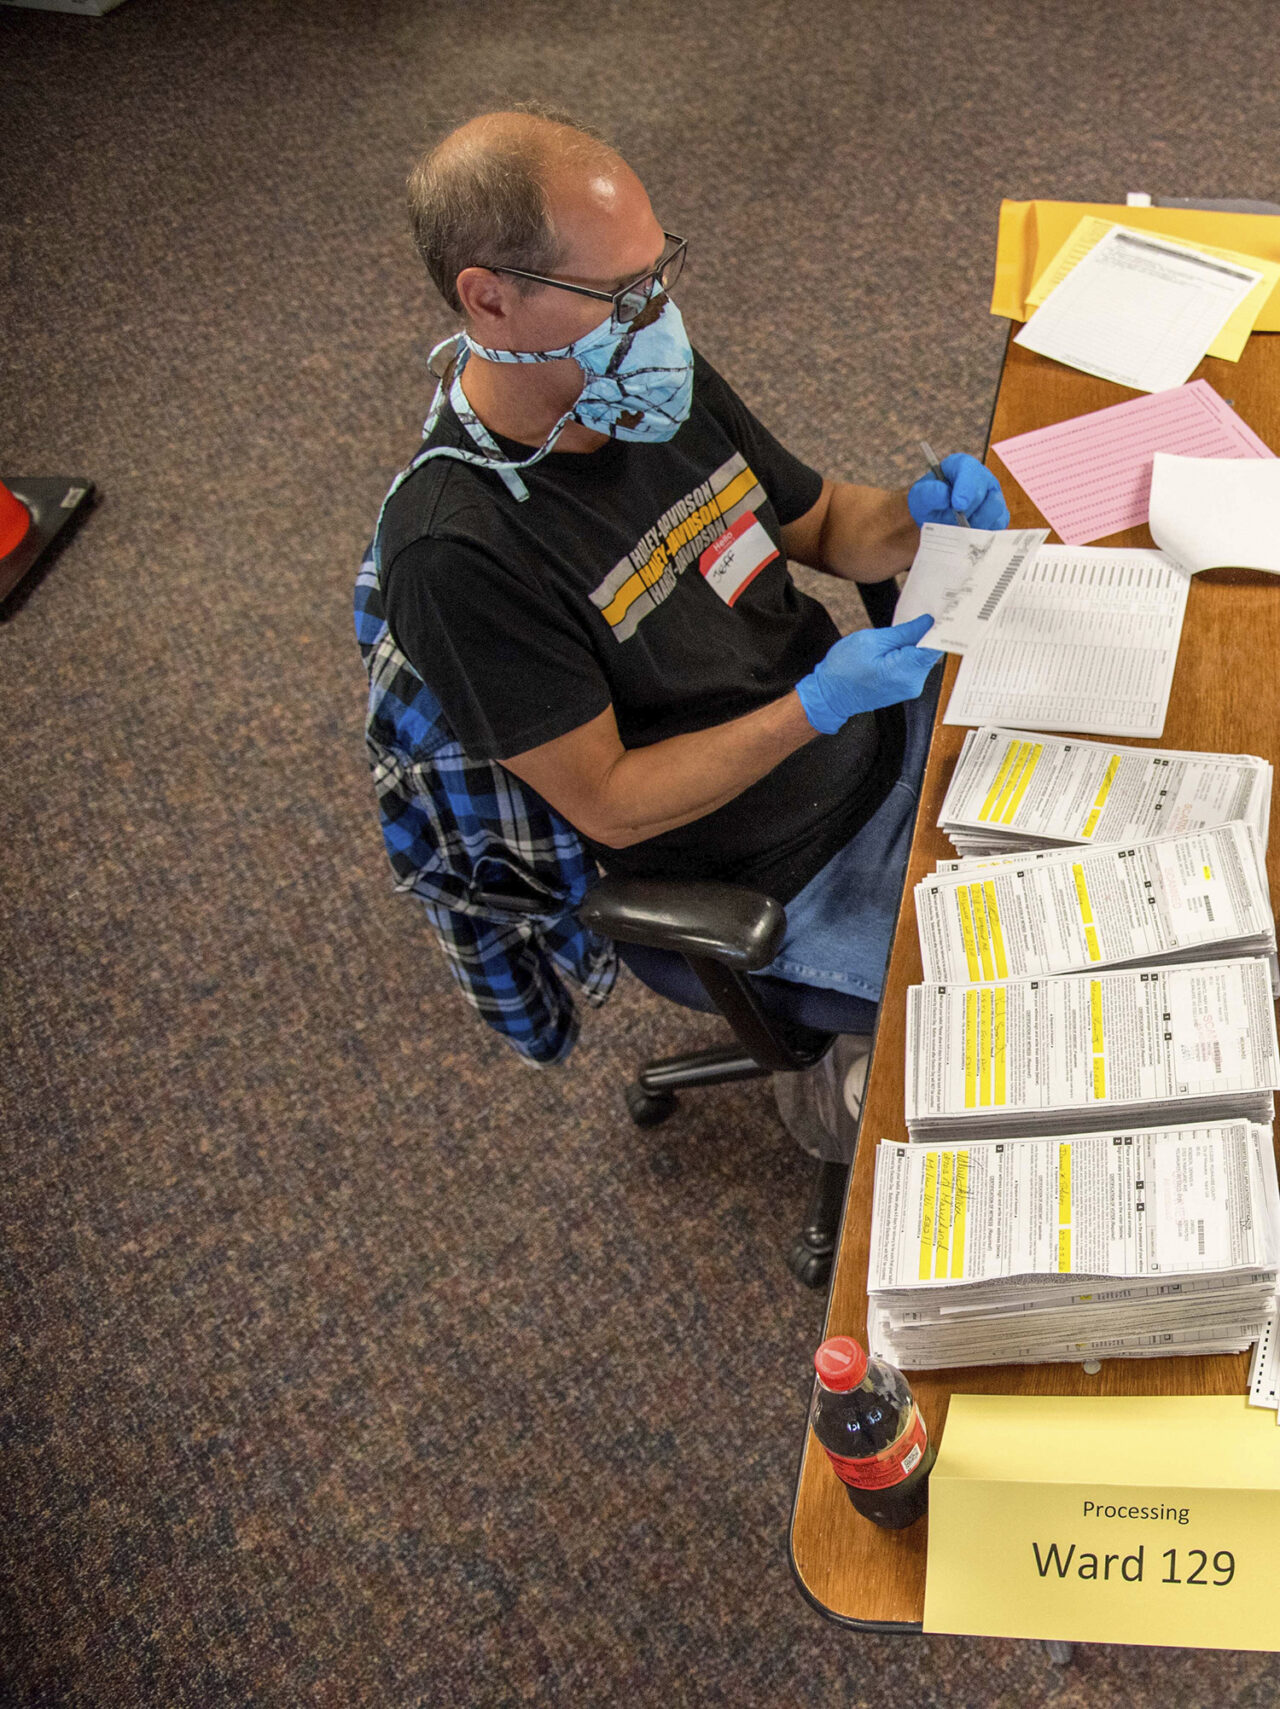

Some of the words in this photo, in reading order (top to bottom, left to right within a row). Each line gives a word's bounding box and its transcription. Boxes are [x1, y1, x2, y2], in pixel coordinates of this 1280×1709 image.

[629, 480, 713, 568] HALEY-AVIDSON
[638, 499, 721, 587] HAEY-AVIDSON
[714, 532, 733, 552] Hello
[649, 517, 726, 604] HARY-AVIDSON
[1083, 1501, 1190, 1525] Processing
[1032, 1542, 1144, 1582] Ward
[1162, 1548, 1236, 1586] 129
